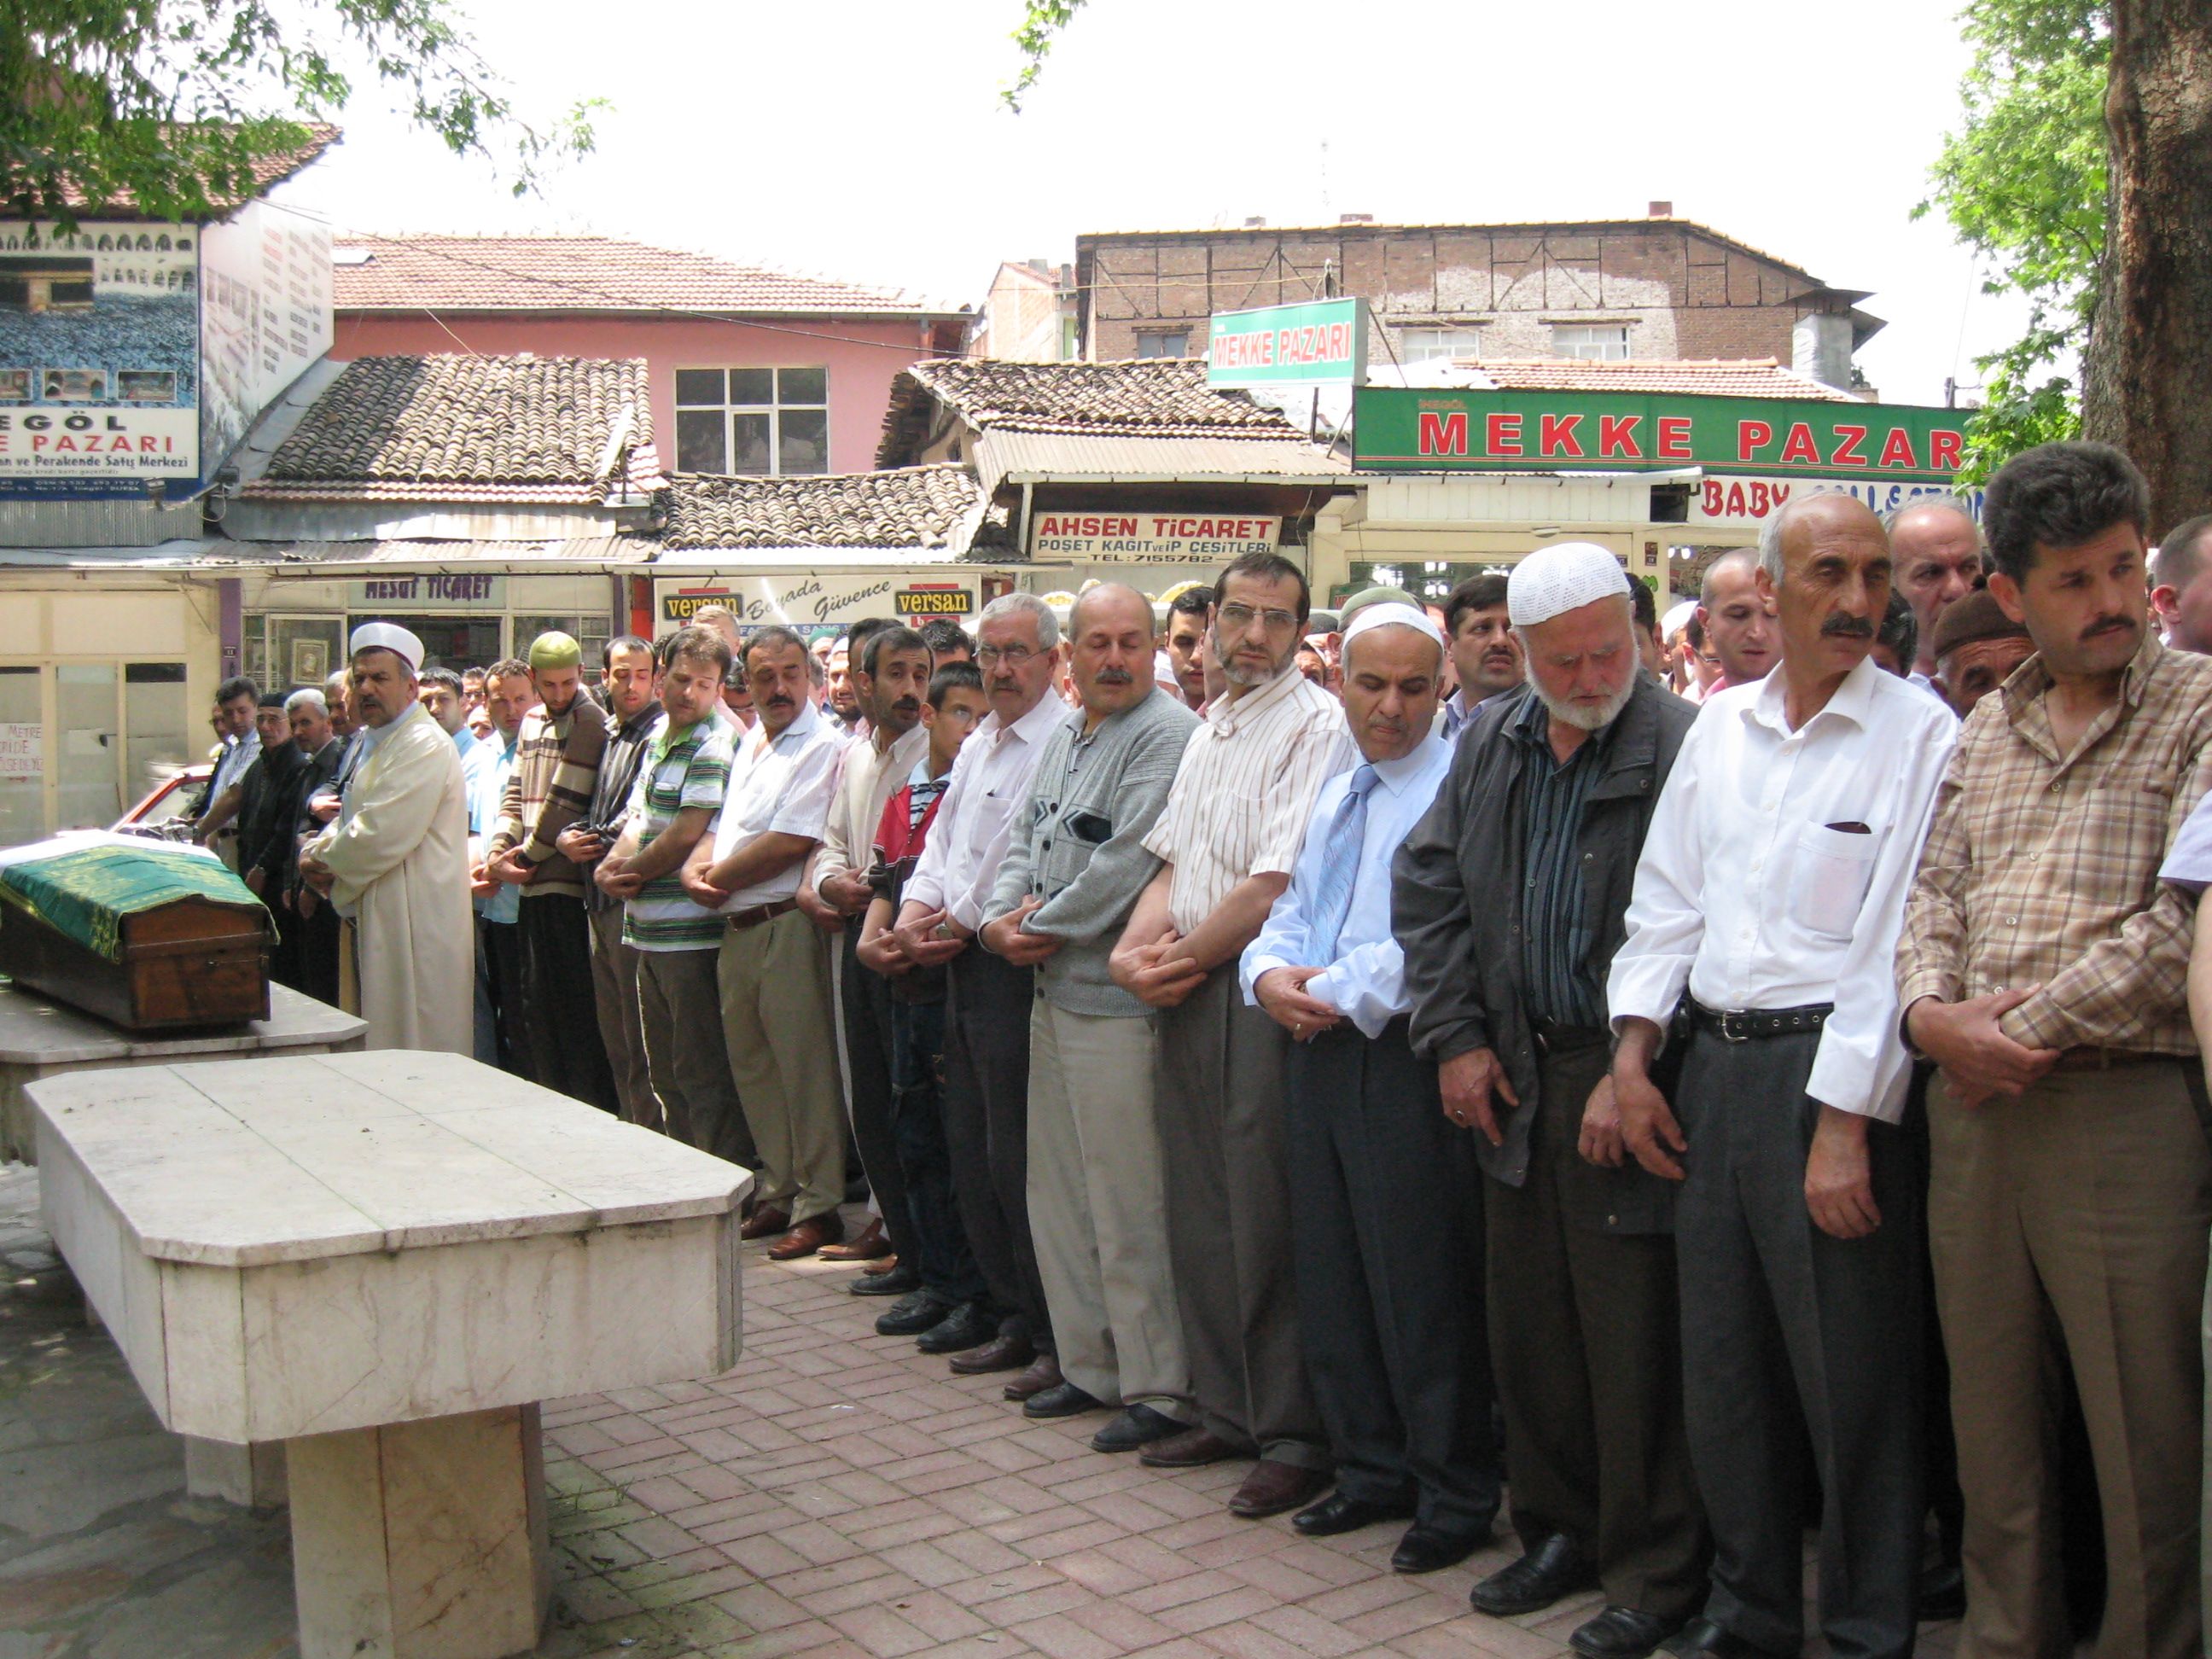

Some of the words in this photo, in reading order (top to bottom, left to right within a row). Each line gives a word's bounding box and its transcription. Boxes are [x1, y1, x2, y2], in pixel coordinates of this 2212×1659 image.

[1213, 331, 1274, 369] MEKKE
[1278, 322, 1351, 365] PAZARI
[17, 457, 31, 466] ve
[35, 456, 101, 466] Perakende
[139, 455, 188, 467] Merkezi
[32, 435, 172, 453] PAZARI
[1417, 412, 1693, 459] MEKKE
[1738, 419, 1991, 471] PAZAR
[1702, 479, 1790, 519] BABY
[1039, 517, 1138, 537] AHSEN
[813, 580, 891, 623] Güvence
[898, 592, 969, 613] versan
